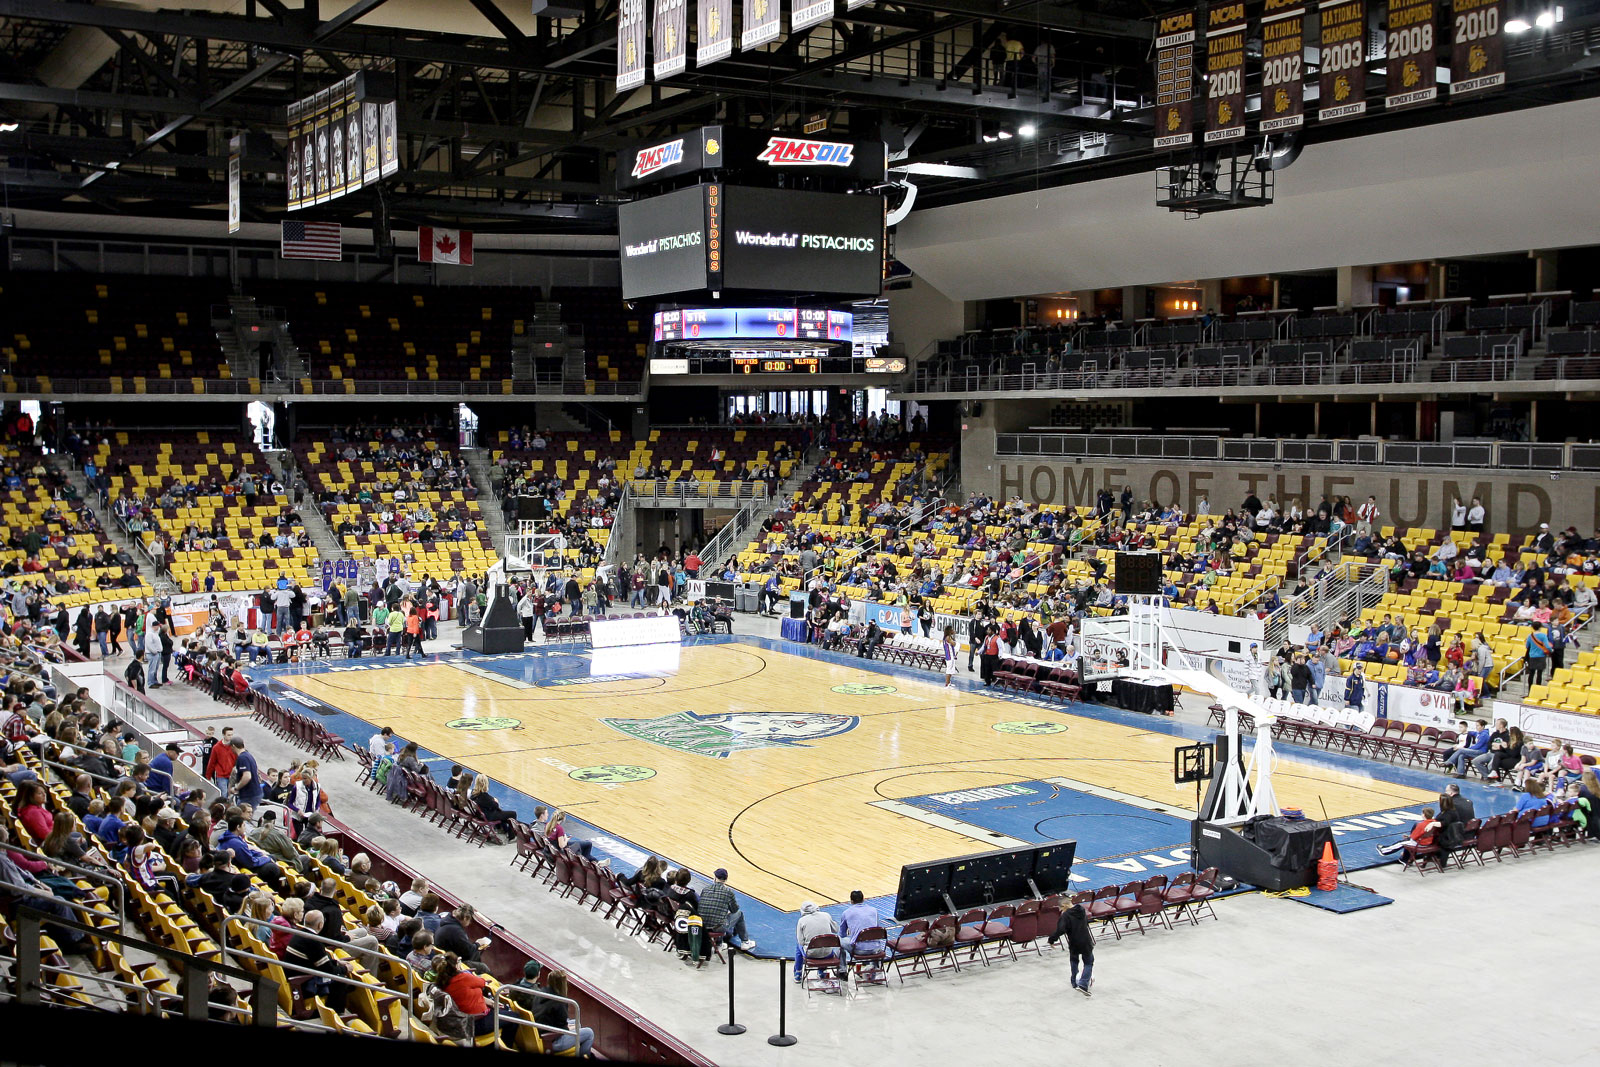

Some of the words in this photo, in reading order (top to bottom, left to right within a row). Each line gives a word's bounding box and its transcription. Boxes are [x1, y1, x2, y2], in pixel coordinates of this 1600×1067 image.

[1160, 13, 1193, 34] NCAA
[1209, 3, 1244, 26] NCAA
[1322, 3, 1362, 27] NATIONAL
[1389, 3, 1432, 29] CHAMPIONS
[1264, 19, 1301, 41] NATIONAL
[1322, 21, 1362, 44] CHAMPIONS
[1456, 7, 1498, 44] 2010
[1159, 33, 1191, 46] TOURNAMENT
[1208, 34, 1243, 55] NATIONAL
[1264, 36, 1301, 58] CHAMPIONS
[1389, 24, 1432, 60] 2008
[1208, 51, 1243, 71] CHAMPIONS
[1322, 40, 1362, 74] 2003
[1264, 55, 1300, 87] 2002
[1209, 69, 1241, 98] 2001
[1454, 80, 1478, 92] WOMEN'S
[1480, 75, 1500, 87] HOCKEY
[1389, 94, 1412, 106] WOMEN'S
[1413, 90, 1431, 101] HOCKEY
[1322, 107, 1343, 119] WOMEN'S
[1344, 104, 1361, 114] HOCKEY
[1263, 119, 1283, 129] WOMEN'S
[1283, 116, 1300, 126] HOCKEY
[1175, 134, 1190, 144] HOCKEY
[1207, 130, 1225, 141] WOMEN'S
[1226, 127, 1242, 138] HOCKEY
[365, 145, 376, 170] 29
[636, 140, 682, 174] AMSOIL
[764, 140, 851, 163] AMSOIL
[709, 185, 719, 271] BULLDOGS
[626, 240, 657, 256] Wonderful
[660, 231, 700, 251] PISTACHIOS
[736, 230, 798, 247] Wonderful
[802, 234, 874, 251] PISTACHIOS
[687, 311, 706, 323] STR
[768, 311, 793, 322] HLM
[801, 310, 825, 321] 10:00
[691, 324, 700, 337] 0
[777, 324, 786, 336] 0
[834, 326, 841, 338] 0
[744, 364, 750, 374] 0
[764, 361, 785, 370] 10:00
[810, 364, 816, 374] 0
[1000, 464, 1126, 508] HOME
[1149, 469, 1213, 514] OF
[1389, 479, 1552, 534] UMD
[1433, 694, 1450, 710] YA
